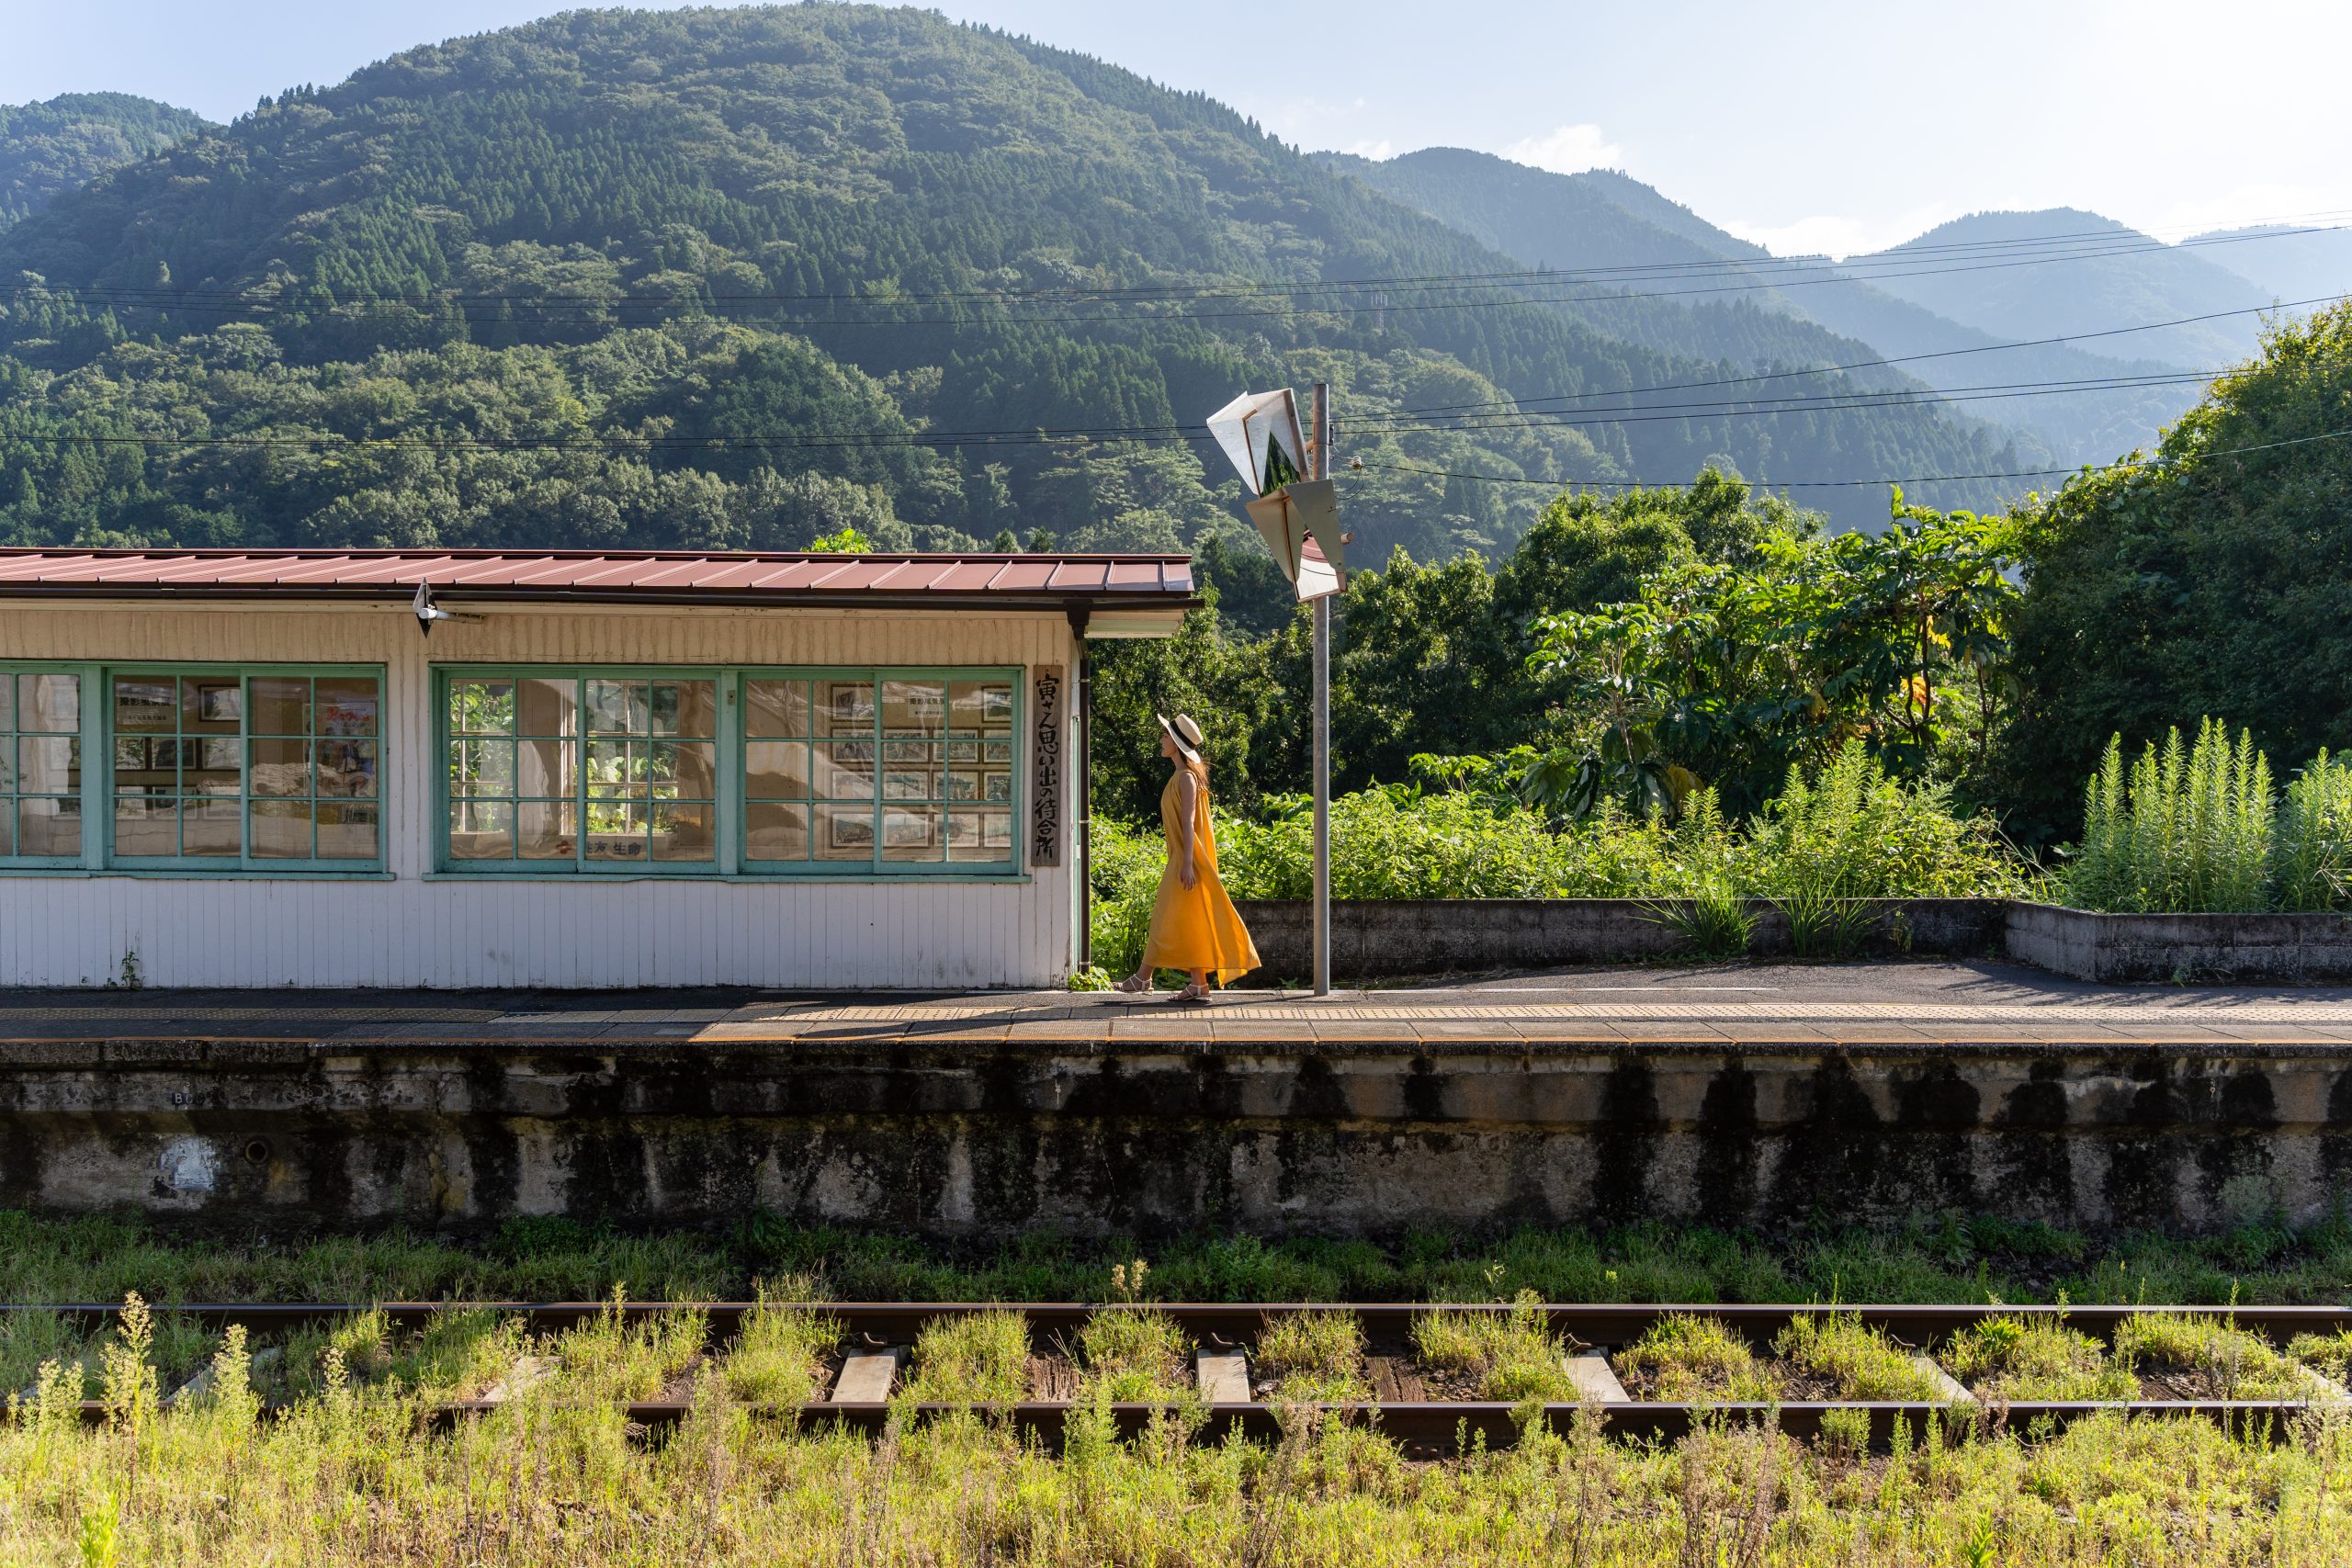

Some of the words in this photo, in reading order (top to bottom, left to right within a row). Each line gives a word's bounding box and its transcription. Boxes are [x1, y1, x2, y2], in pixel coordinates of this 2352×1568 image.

[1035, 672, 1059, 859] 寅さん思い出の待合所
